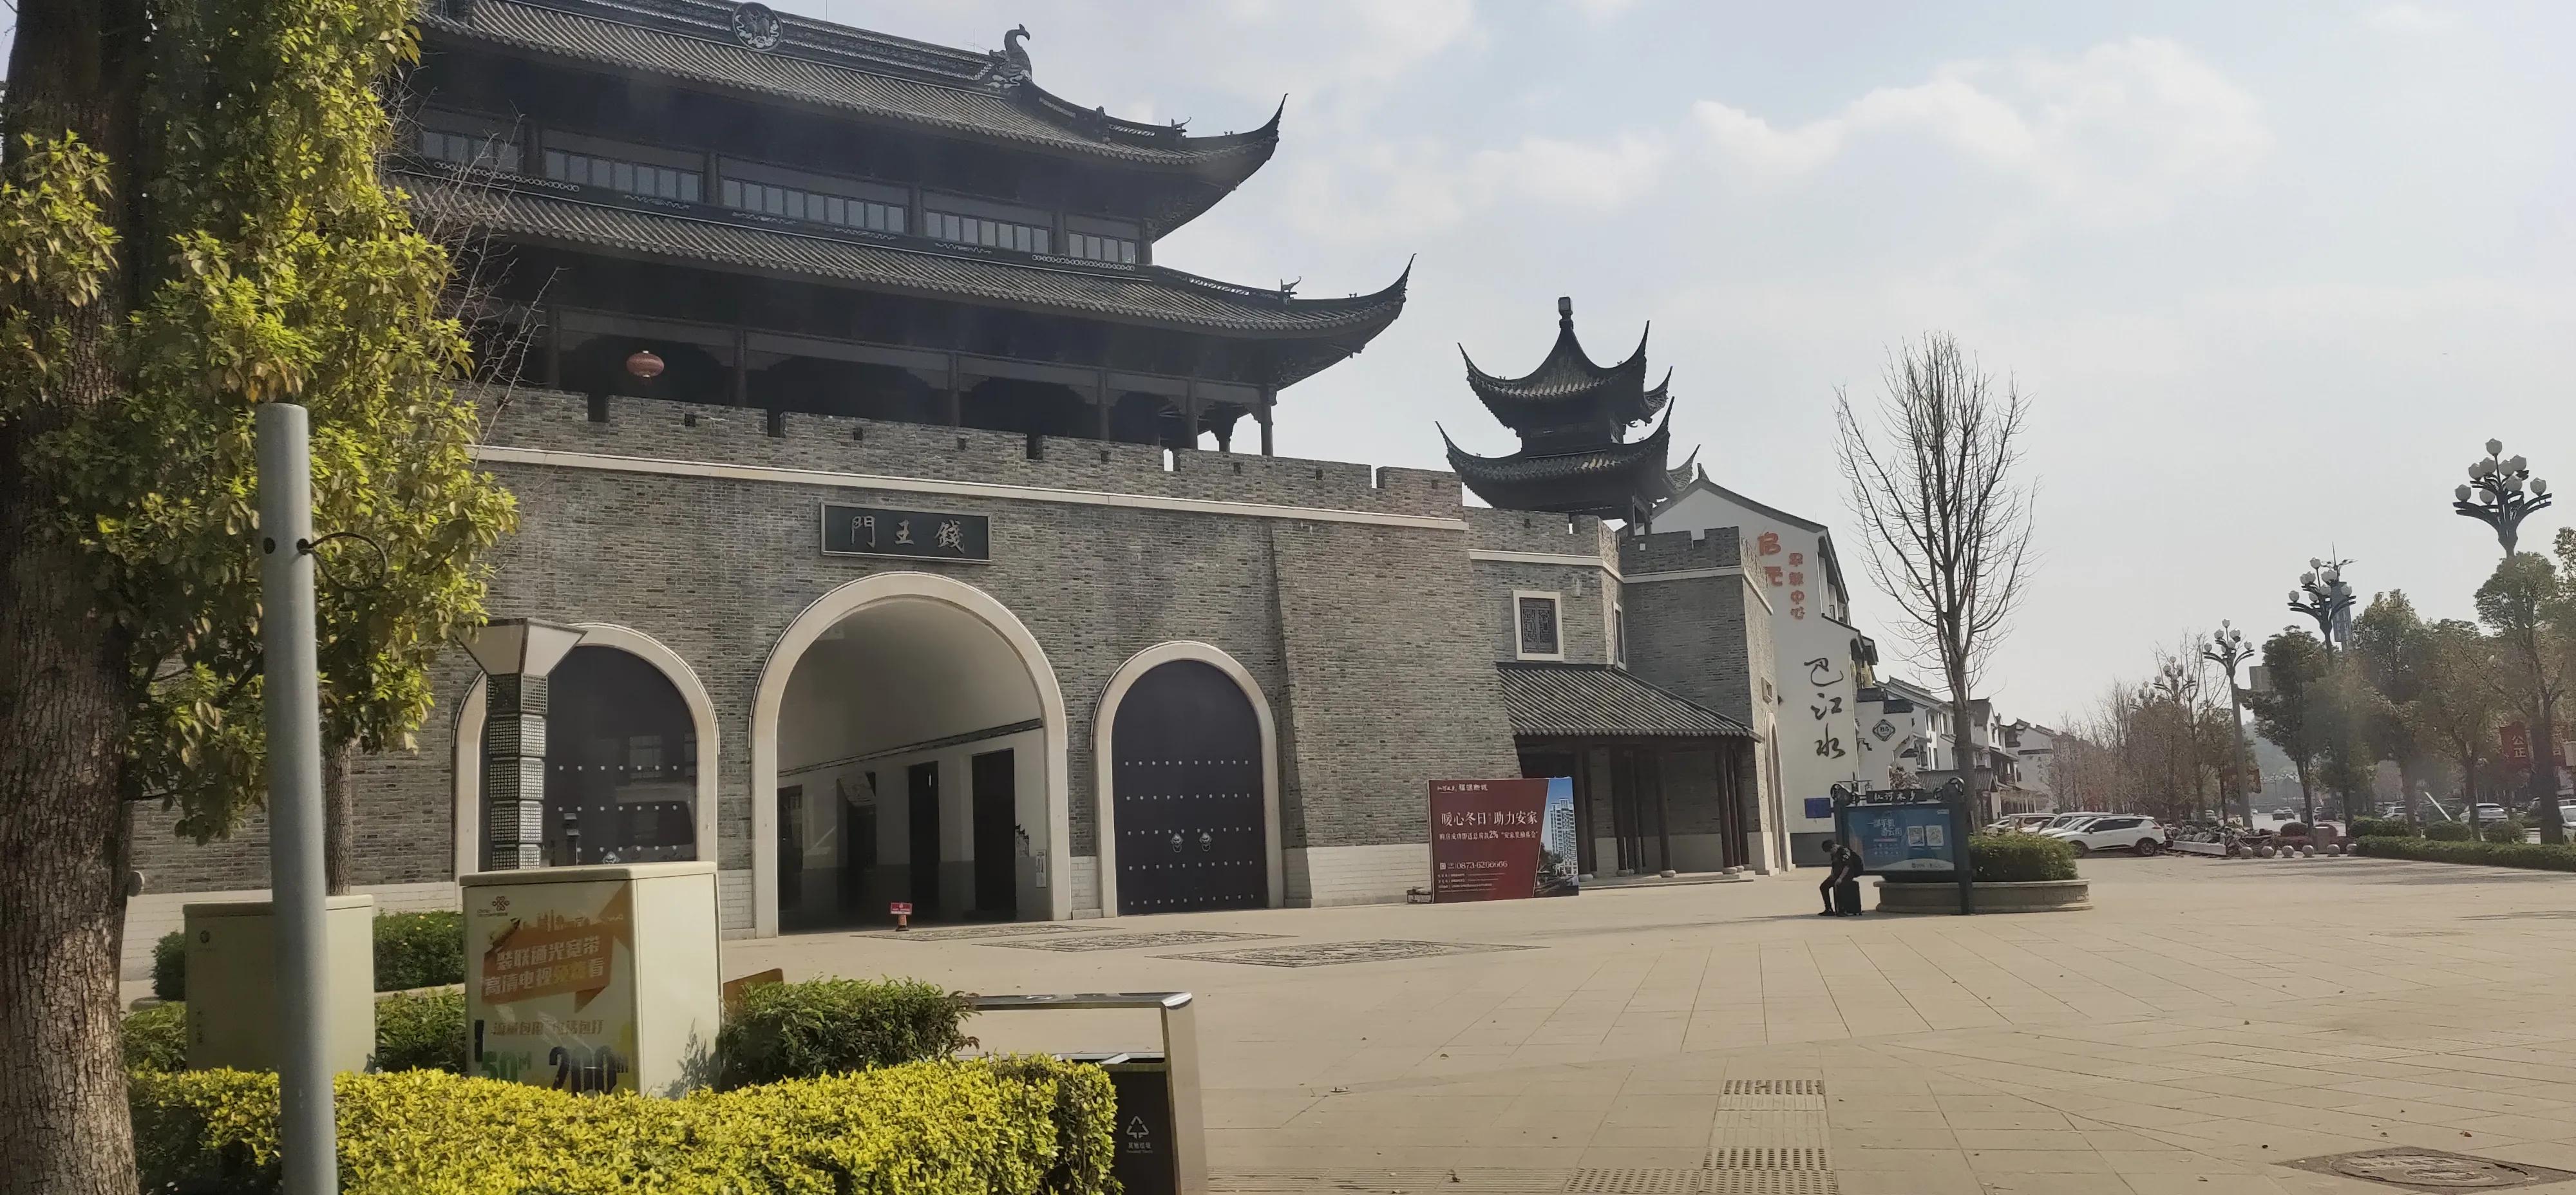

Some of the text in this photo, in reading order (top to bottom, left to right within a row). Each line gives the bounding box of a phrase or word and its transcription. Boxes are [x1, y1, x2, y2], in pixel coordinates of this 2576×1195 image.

[2512, 735, 2526, 758] 公正
[1441, 811, 1538, 827] 暖心冬日 助力安家
